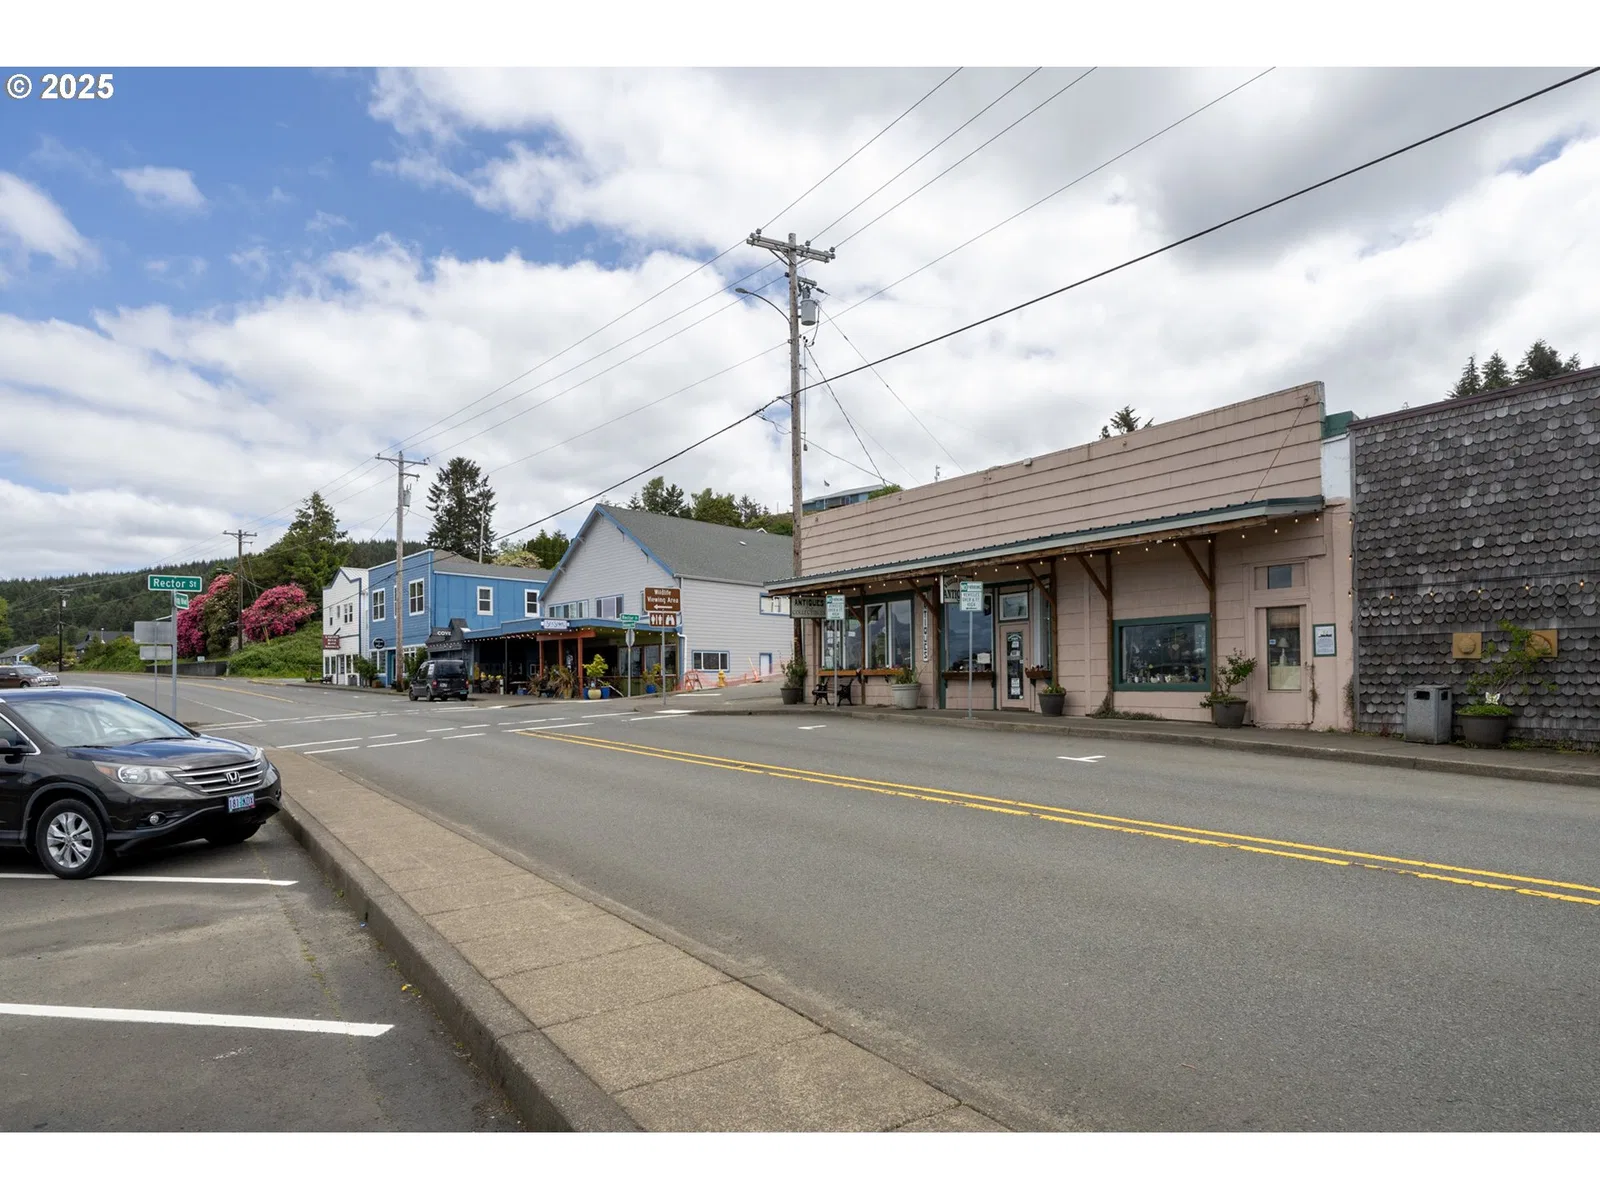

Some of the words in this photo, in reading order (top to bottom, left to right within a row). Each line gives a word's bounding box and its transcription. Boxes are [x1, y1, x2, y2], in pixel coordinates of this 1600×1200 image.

[153, 578, 185, 588] Rector
[189, 580, 197, 588] St
[654, 588, 671, 596] Wildlife
[647, 596, 666, 604] Viewing
[667, 596, 679, 604] Area
[794, 598, 825, 607] ANTIQUES
